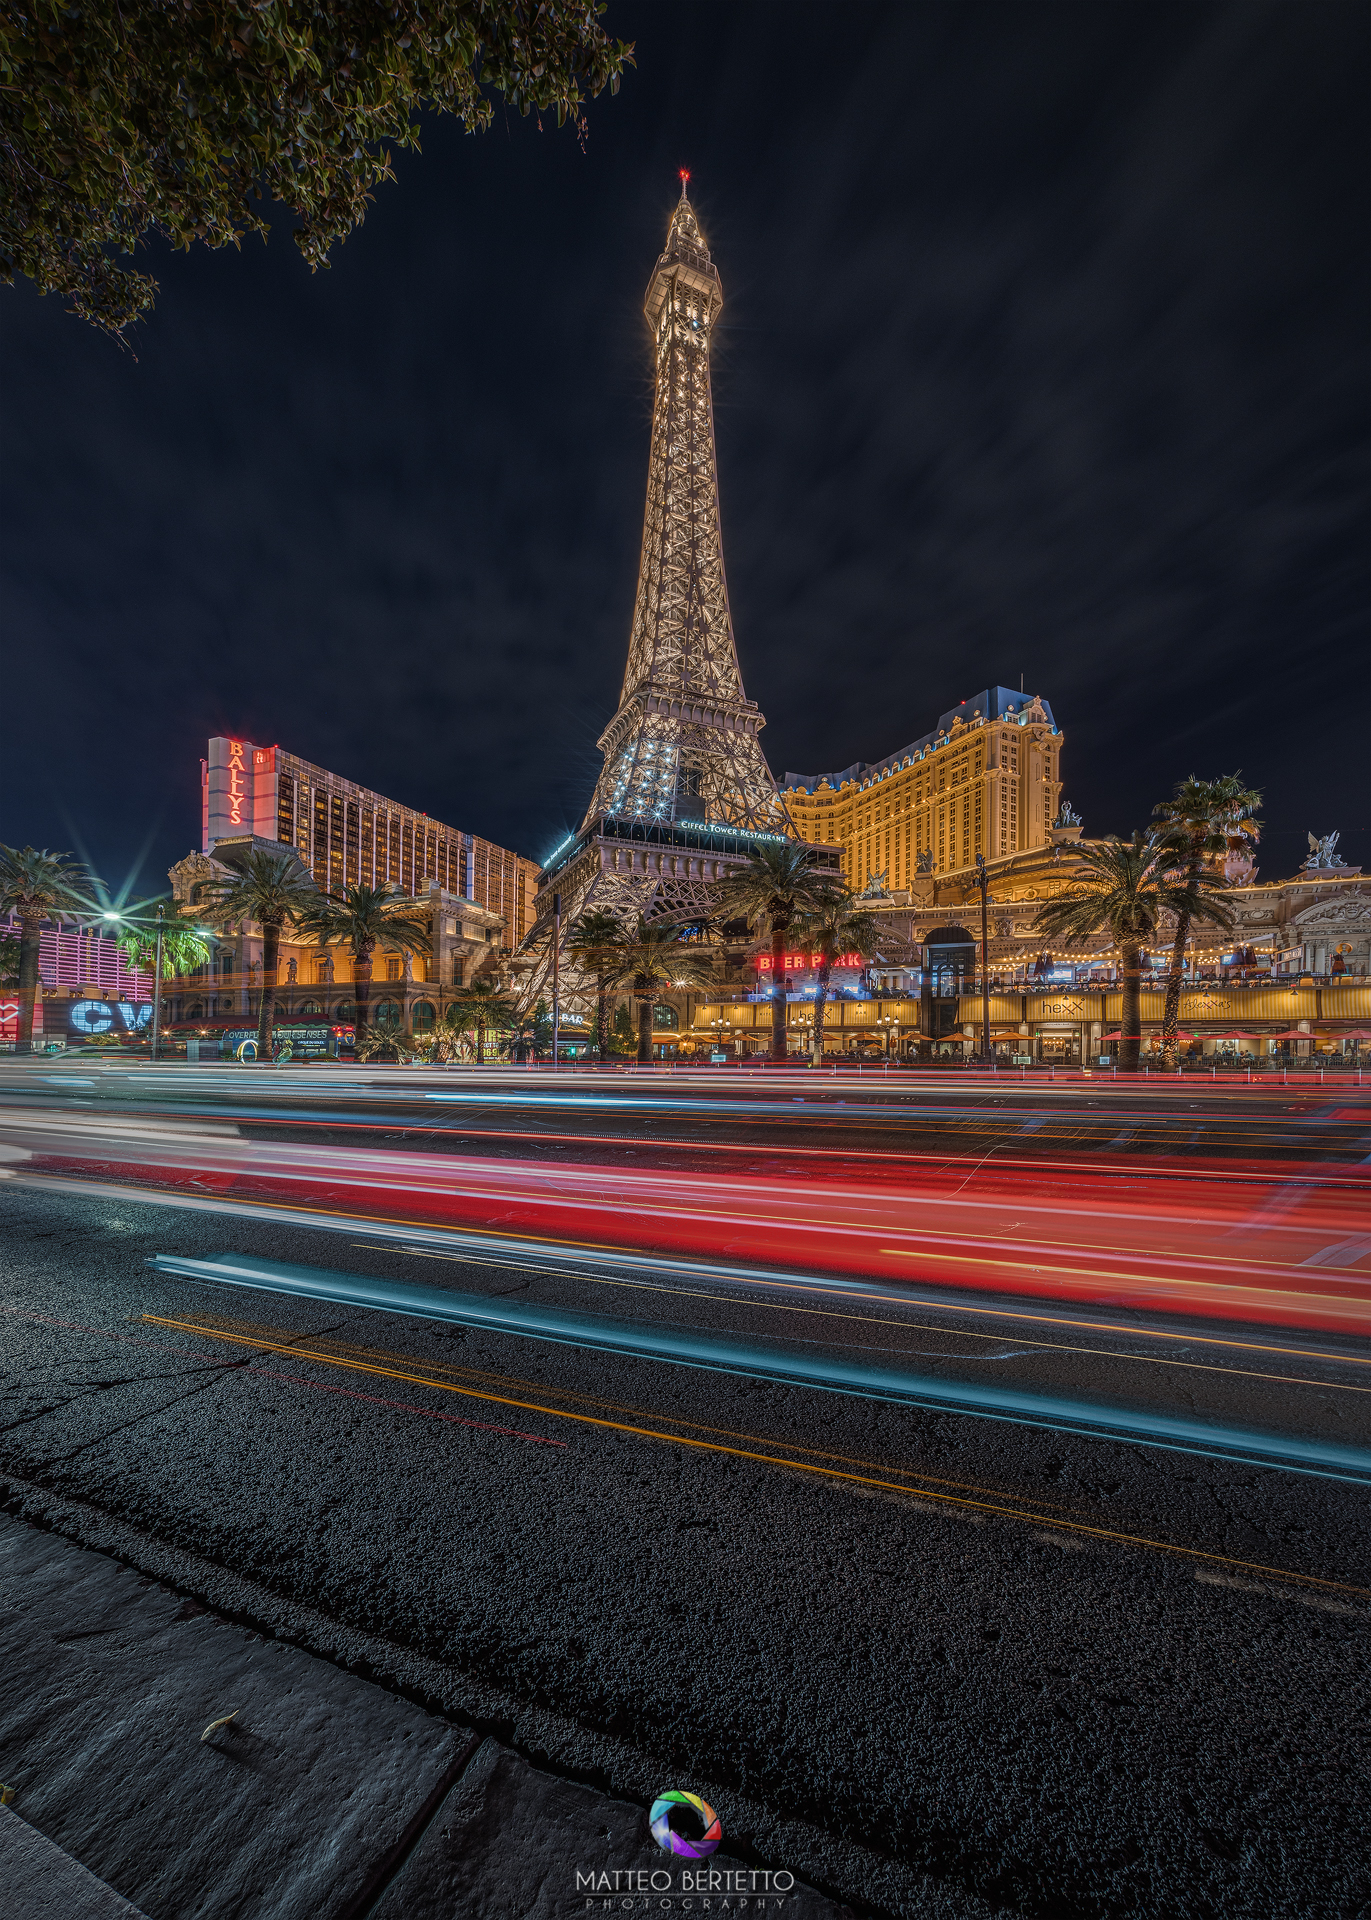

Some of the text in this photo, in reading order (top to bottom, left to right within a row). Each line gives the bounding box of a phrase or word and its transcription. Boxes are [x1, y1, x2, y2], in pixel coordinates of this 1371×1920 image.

[227, 741, 246, 825] BALLYS
[681, 821, 786, 843] EIFFEL TOWER RESTAURANT
[760, 956, 804, 969] BER
[561, 1013, 584, 1025] BAR
[799, 1008, 832, 1022] hex
[229, 1031, 259, 1039] OVERFL
[297, 1030, 327, 1039] SENSES
